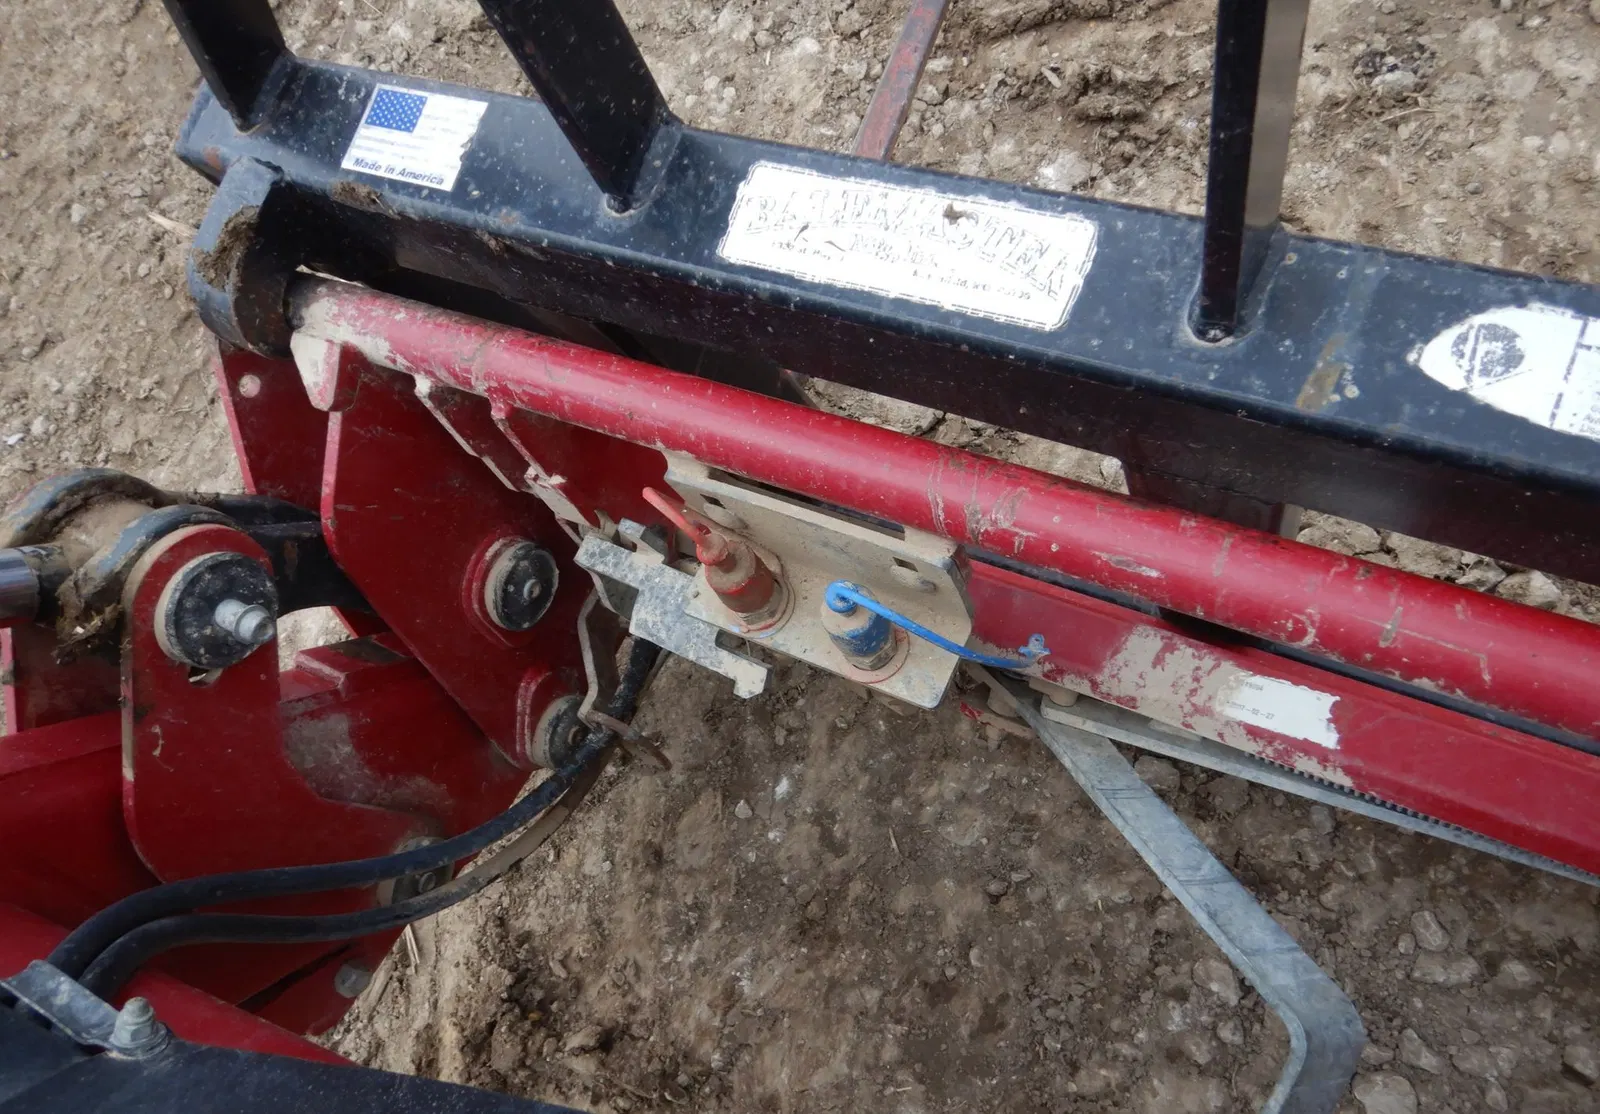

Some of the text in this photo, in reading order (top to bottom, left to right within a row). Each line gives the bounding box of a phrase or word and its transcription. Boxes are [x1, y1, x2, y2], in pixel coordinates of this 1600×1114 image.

[353, 157, 445, 185] Made in America
